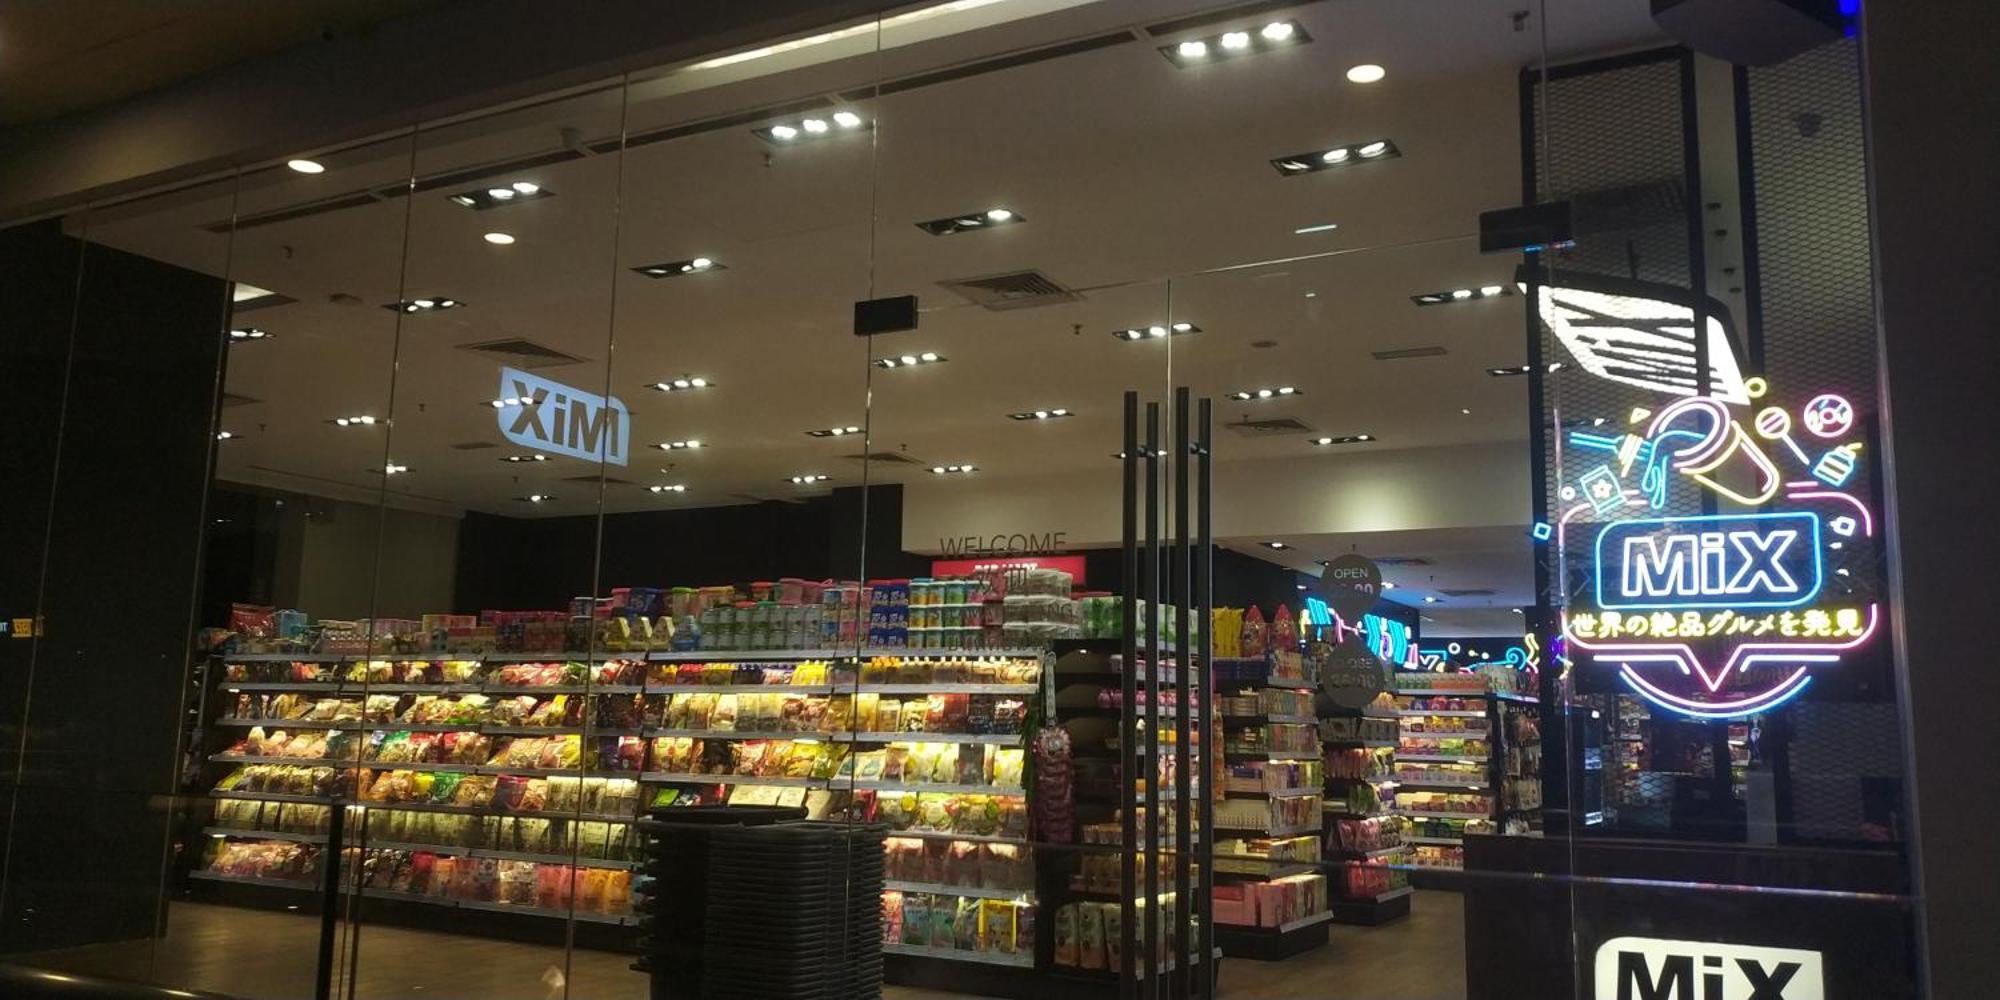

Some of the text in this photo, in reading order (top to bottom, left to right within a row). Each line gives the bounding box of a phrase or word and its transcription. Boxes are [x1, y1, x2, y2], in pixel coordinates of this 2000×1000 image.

[940, 532, 1067, 559] WELCOME
[1621, 529, 1799, 598] MiX
[1333, 567, 1369, 580] OPEN
[1617, 950, 1802, 1000] MiX
